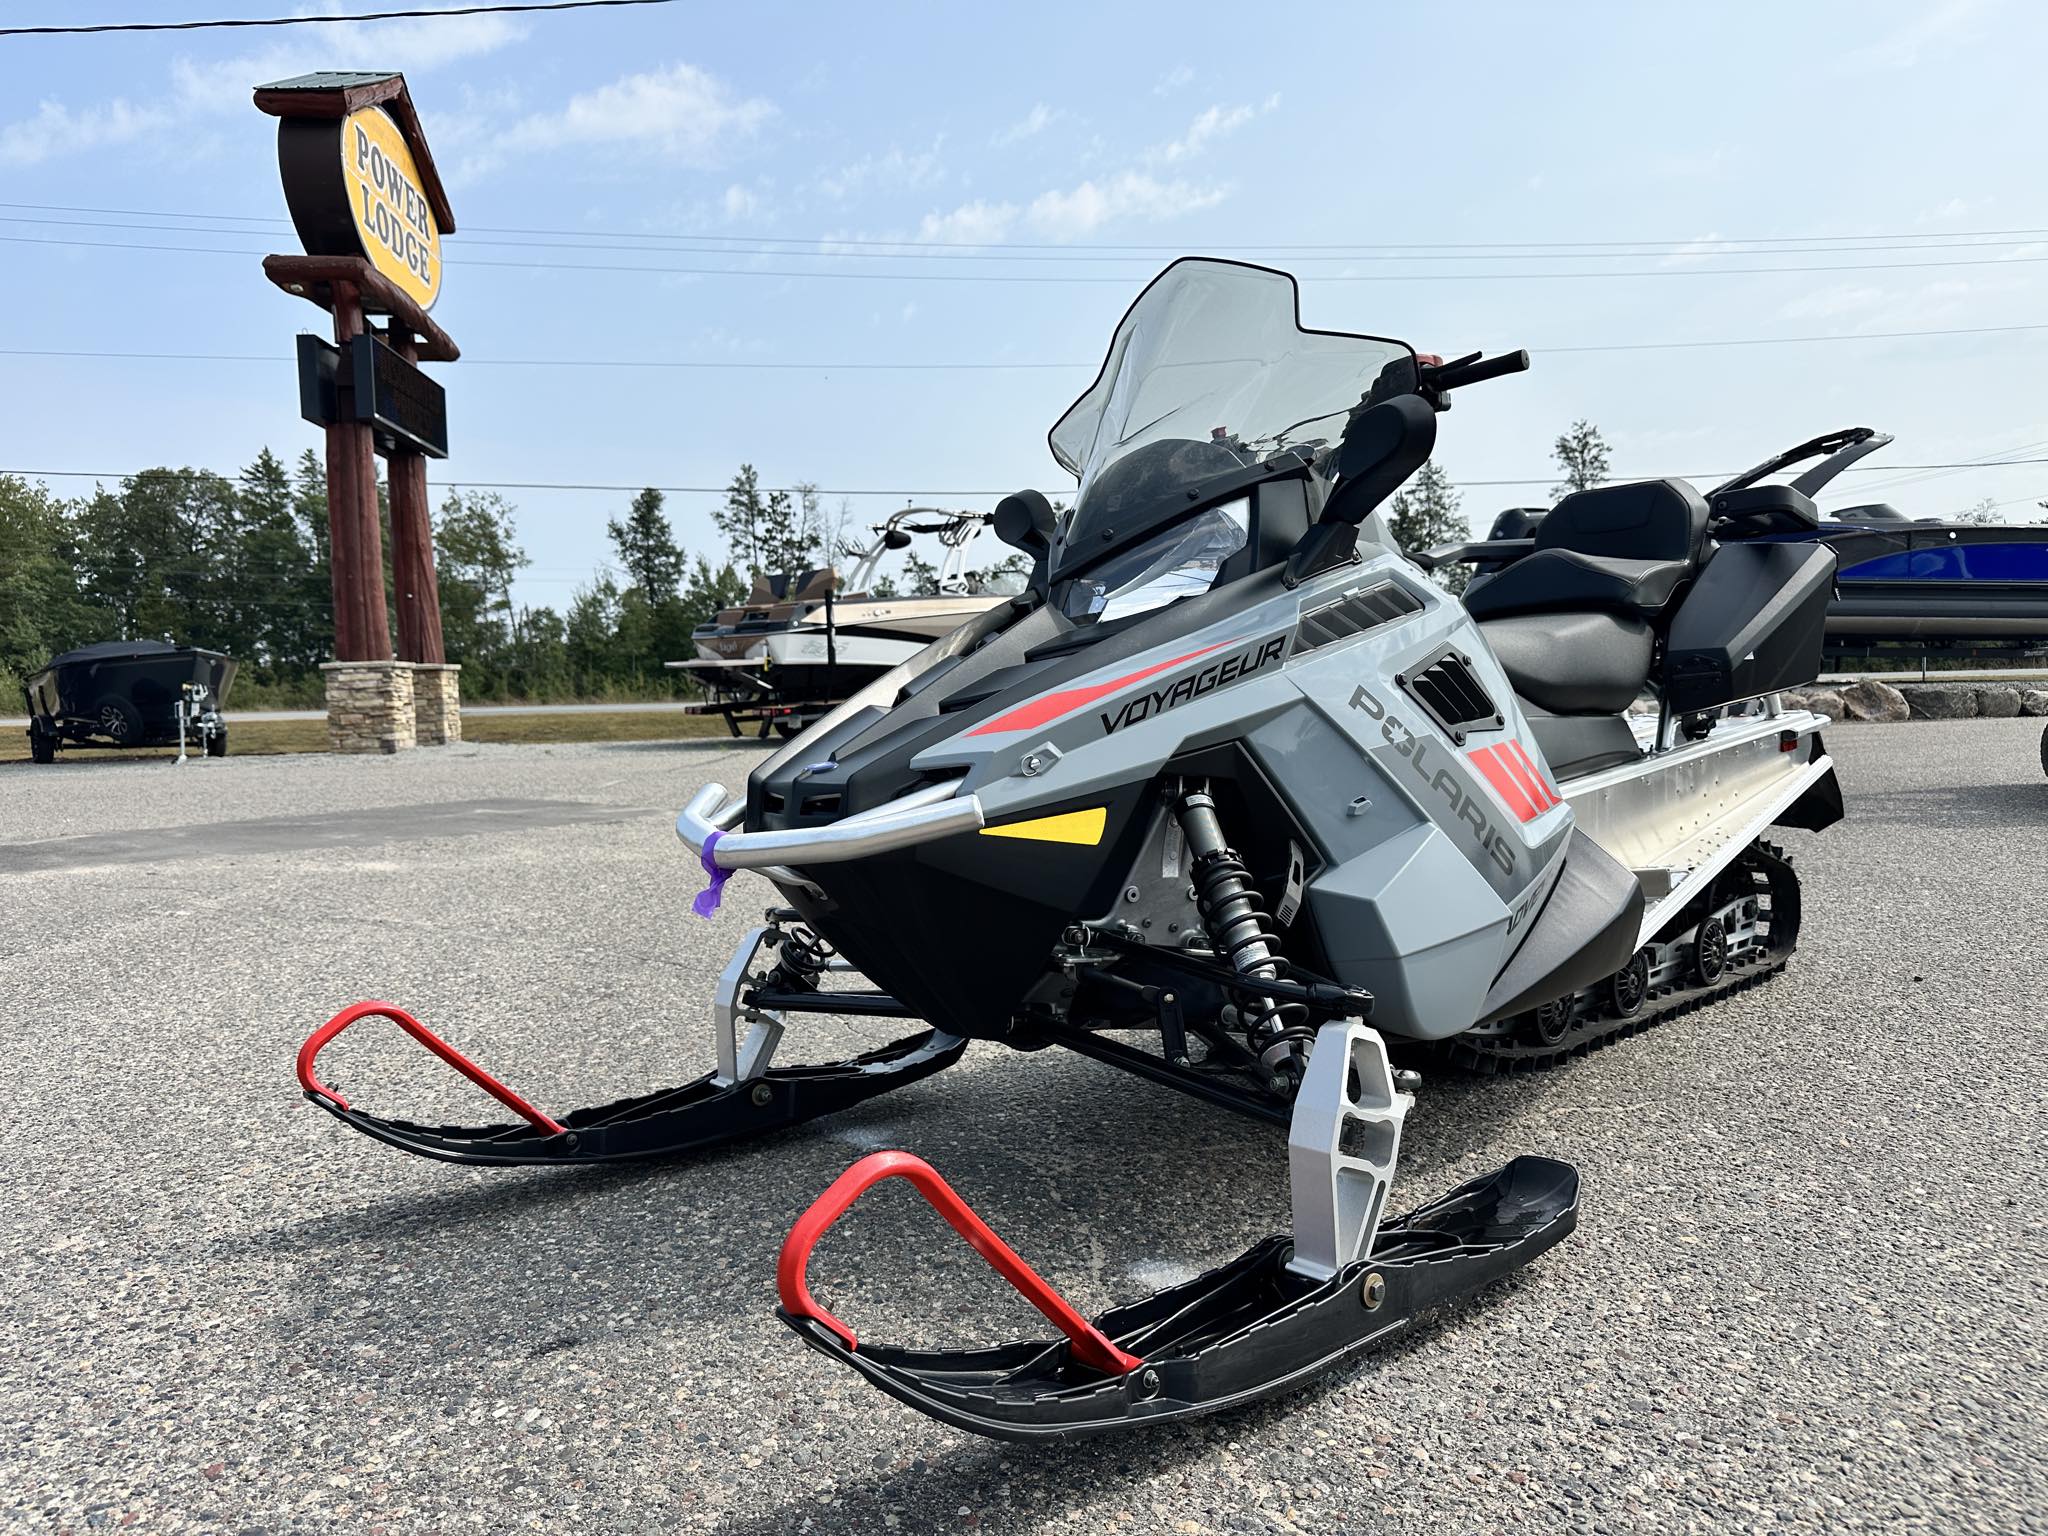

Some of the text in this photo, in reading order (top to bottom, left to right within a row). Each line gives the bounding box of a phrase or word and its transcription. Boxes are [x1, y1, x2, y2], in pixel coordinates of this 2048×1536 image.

[356, 125, 430, 242] POWER
[362, 184, 431, 284] LODGE
[1101, 635, 1287, 735] VOYAGEUR
[1348, 684, 1516, 876] POLARIS
